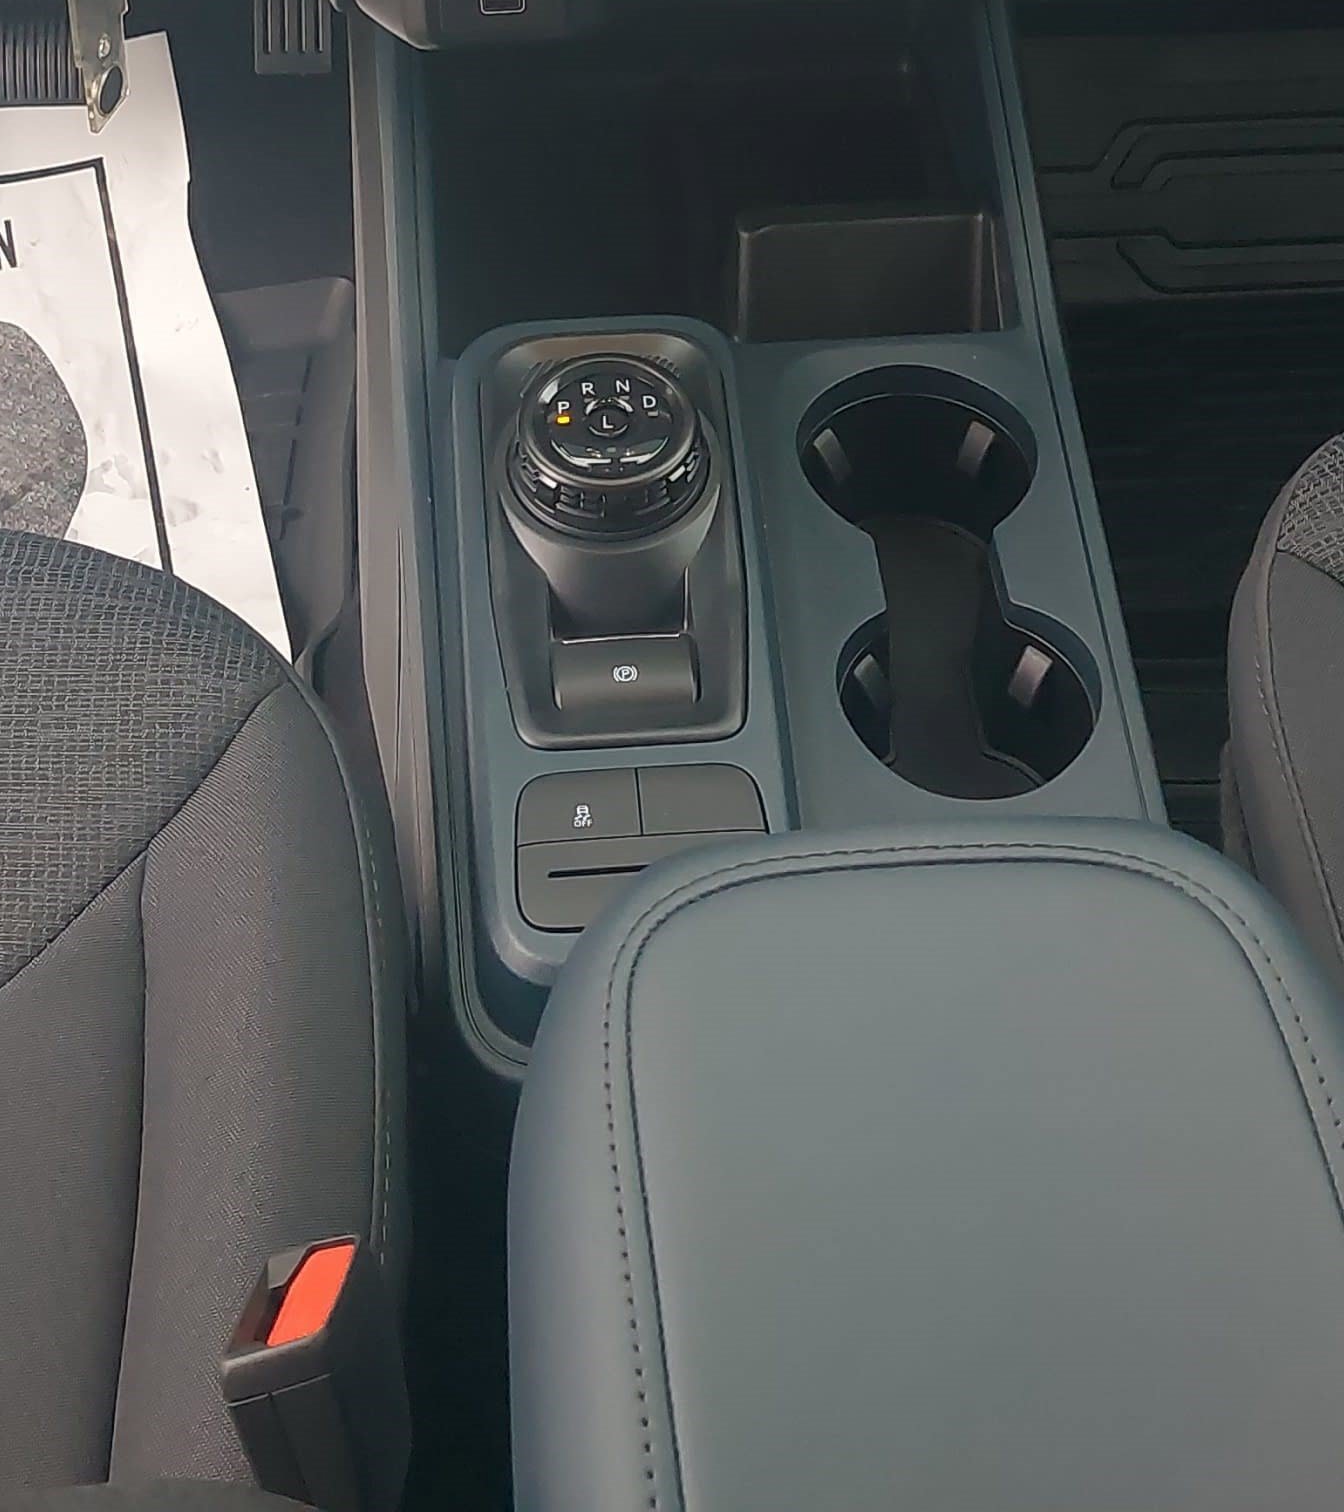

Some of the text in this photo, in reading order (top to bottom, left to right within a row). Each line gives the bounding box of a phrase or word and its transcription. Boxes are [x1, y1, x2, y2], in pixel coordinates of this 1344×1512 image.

[581, 382, 596, 396] R
[615, 379, 631, 393] N
[557, 401, 571, 415] P
[642, 395, 657, 409] D
[602, 415, 614, 429] L
[573, 819, 593, 828] OFF
